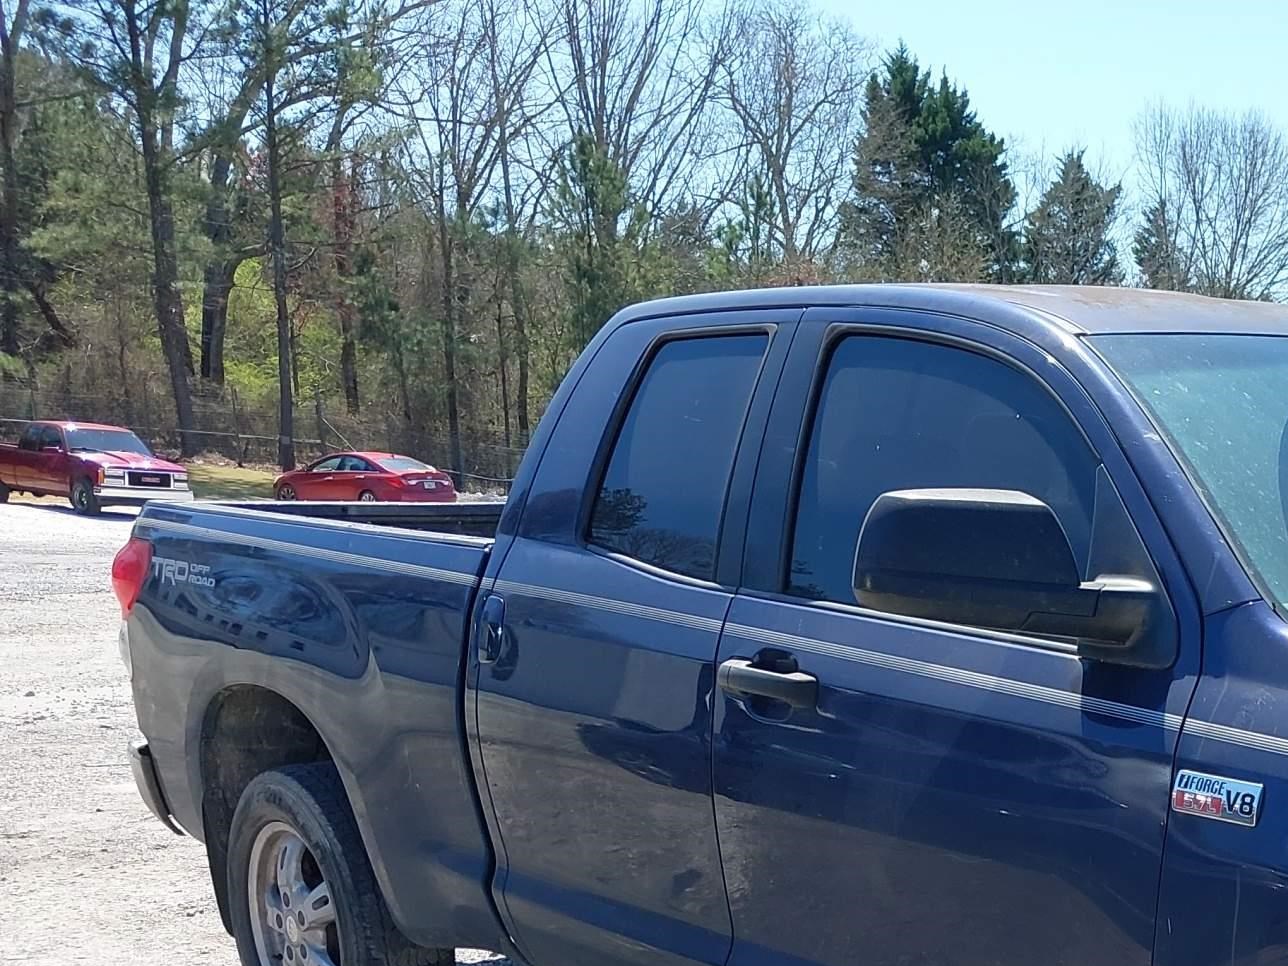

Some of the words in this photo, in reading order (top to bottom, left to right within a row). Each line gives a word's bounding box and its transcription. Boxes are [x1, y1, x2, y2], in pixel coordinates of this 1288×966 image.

[152, 556, 189, 586] TRD
[190, 563, 211, 575] OFF
[188, 574, 216, 588] ROAD
[1225, 788, 1256, 817] V8
